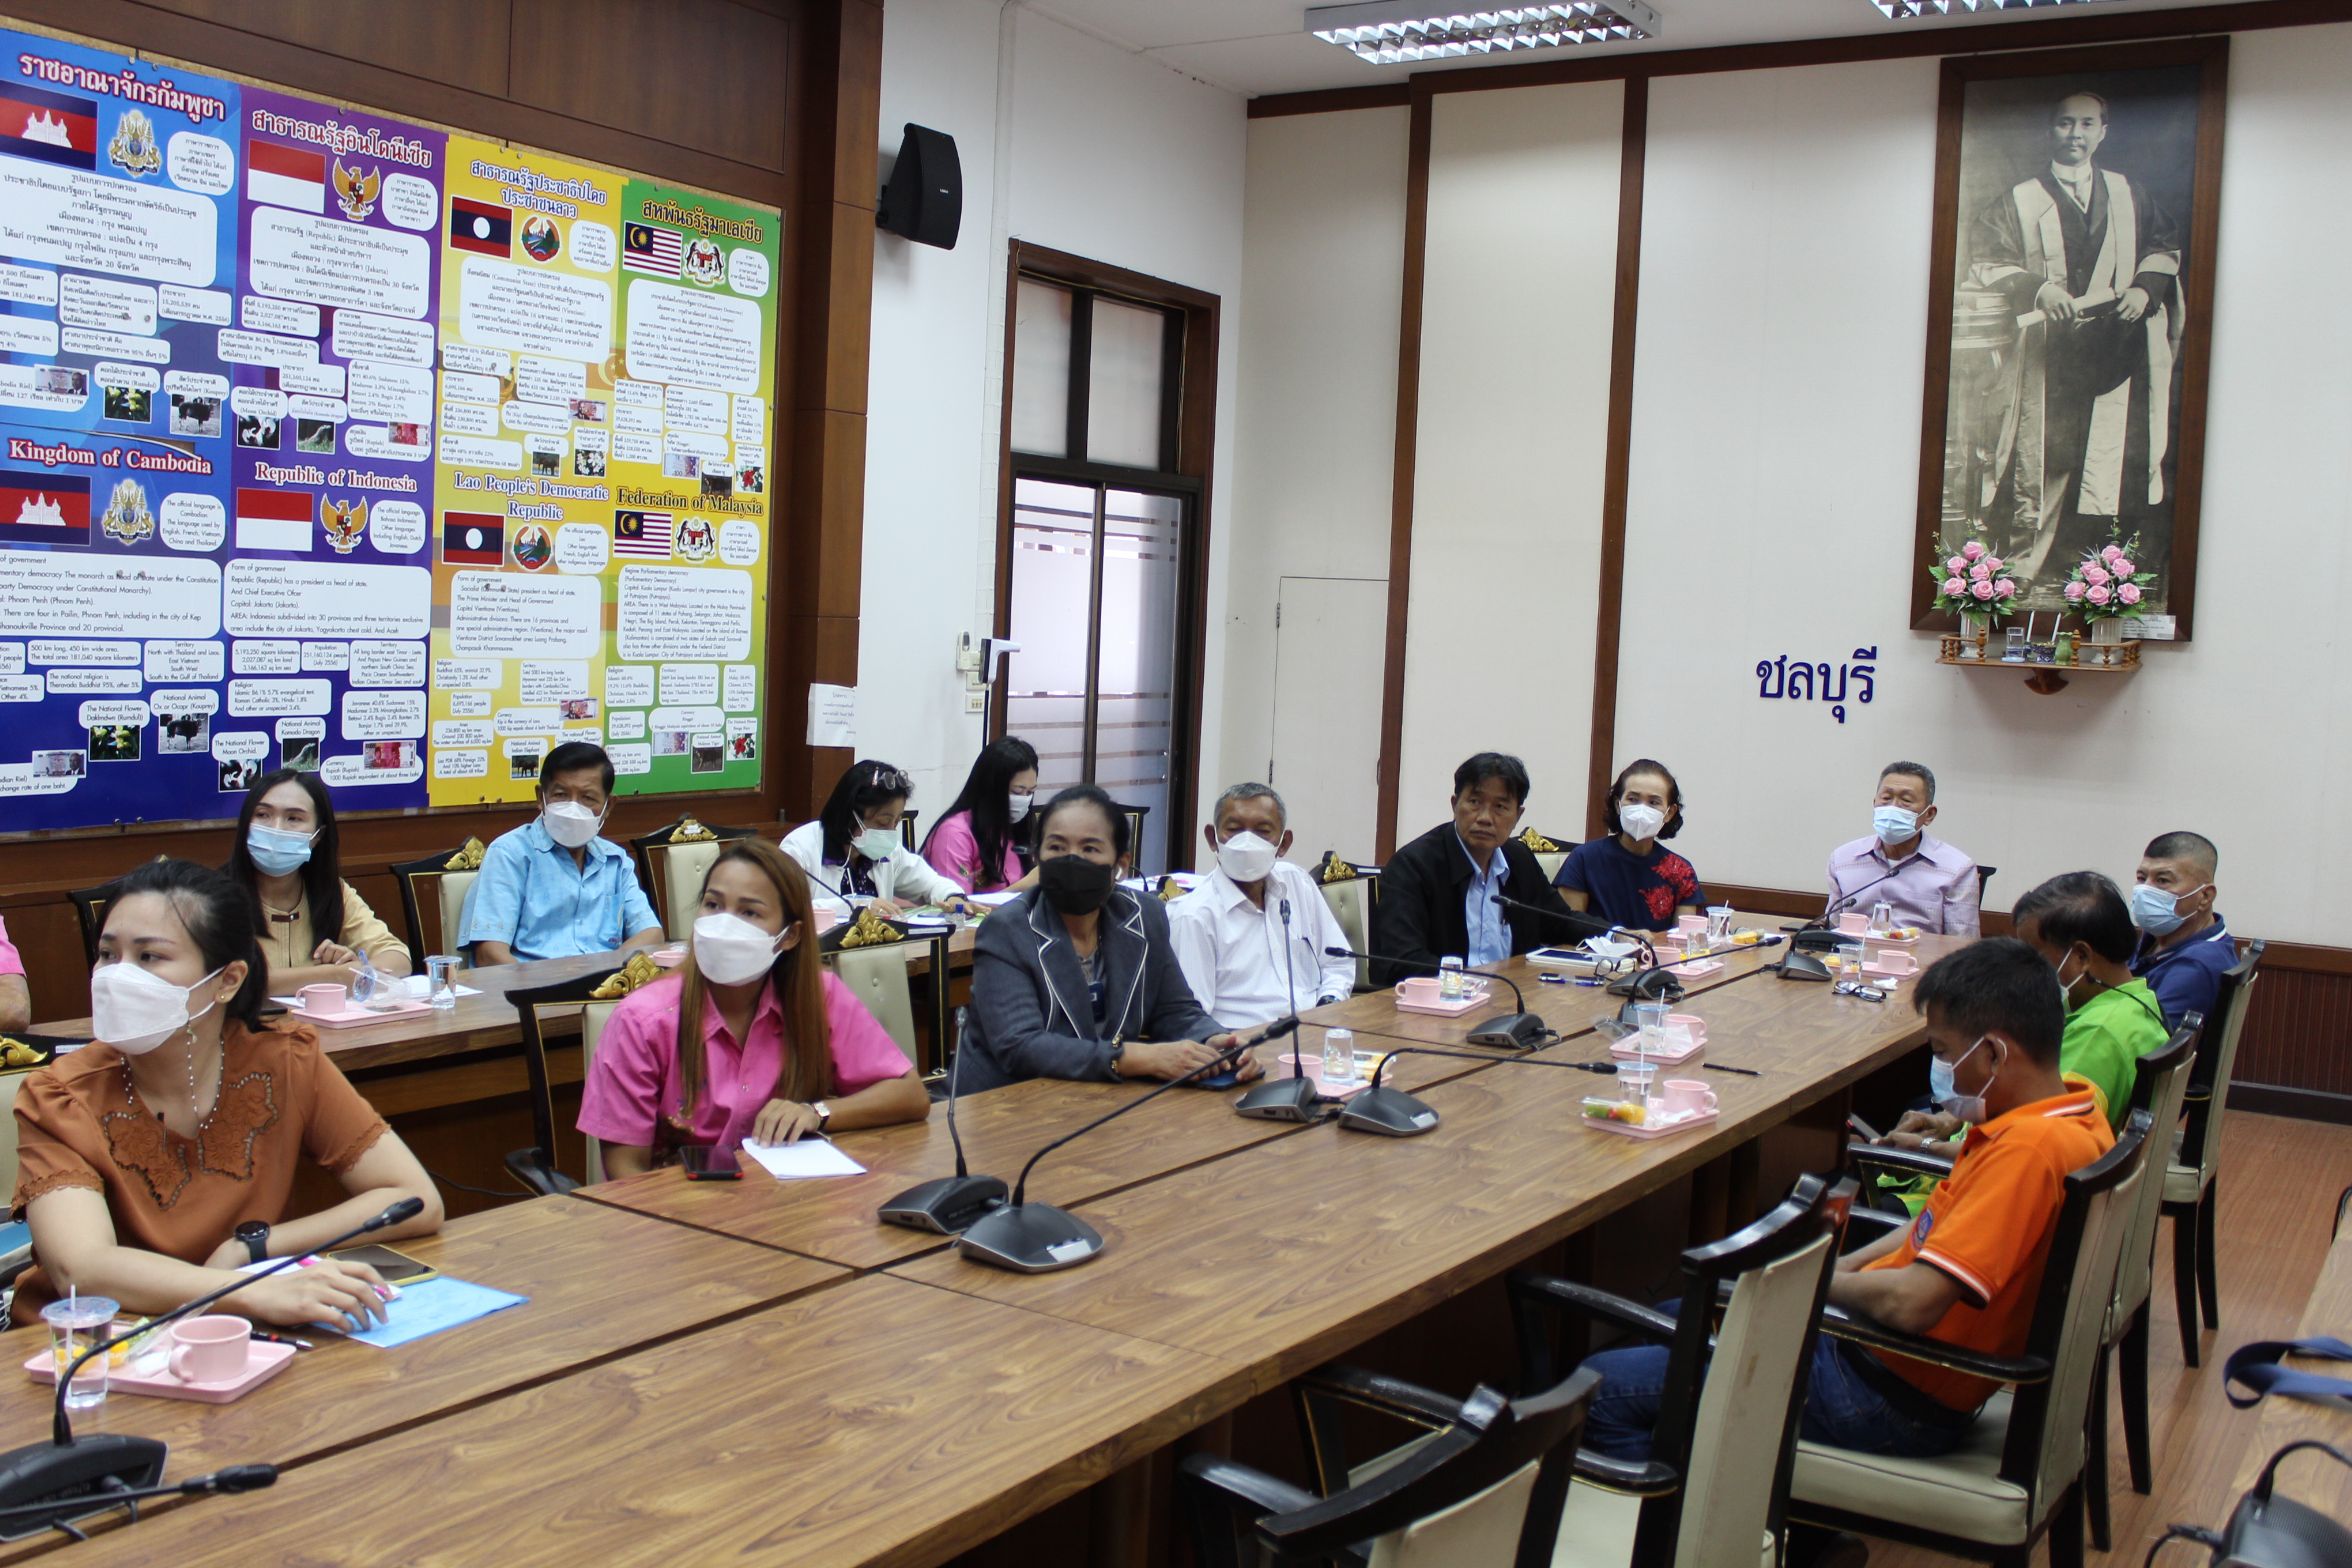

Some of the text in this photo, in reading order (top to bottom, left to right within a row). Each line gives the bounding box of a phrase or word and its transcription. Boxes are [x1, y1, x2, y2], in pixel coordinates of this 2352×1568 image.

[20, 54, 225, 123] ราชอาณาจักรกัมพูชา
[253, 110, 432, 168] สาธารณรัฐอินโดนีเซีย
[471, 161, 607, 206] สาธารณรัฐประชาธิปไตย
[502, 189, 577, 219] ประชาชนลาว
[642, 200, 763, 244] สหพันธรัฐมาเลเซีย
[306, 230, 336, 242] (Republic)
[105, 260, 114, 268] 20
[10, 439, 212, 474] Kingdom of Cambodia
[257, 463, 417, 491] Republic of Indonesia
[455, 472, 608, 500] Lao People's Democratic
[193, 501, 216, 510] language
[618, 488, 763, 517] Federation of Malaysia
[180, 510, 208, 518] Cambodian
[508, 501, 563, 521] Republic
[177, 519, 199, 528] language
[214, 521, 220, 529] by
[247, 563, 253, 571] of
[27, 570, 63, 580] democracy
[64, 570, 76, 578] The
[157, 574, 174, 582] under
[176, 574, 184, 583] the
[186, 575, 218, 583] Constitution
[231, 575, 254, 584] Republic
[256, 576, 282, 585] (Republic)
[301, 578, 325, 586] president
[18, 582, 54, 593] Democracy
[56, 583, 74, 591] under
[76, 584, 117, 593] Constitutional
[261, 588, 285, 596] Executive
[7, 594, 30, 603] Phnom
[32, 595, 48, 604] Penh
[50, 595, 74, 604] (Phnom
[254, 600, 273, 608] Jakarta
[3, 608, 22, 617] There
[37, 608, 50, 617] four
[82, 610, 102, 618] Phnom
[122, 611, 150, 621] including
[159, 611, 169, 620] the
[170, 613, 180, 622] city
[190, 613, 201, 622] Kep
[39, 623, 66, 631] Province
[68, 623, 80, 631] and
[83, 623, 92, 632] 20
[1756, 646, 1878, 723] ชลบุรี
[302, 728, 320, 736] Dragon
